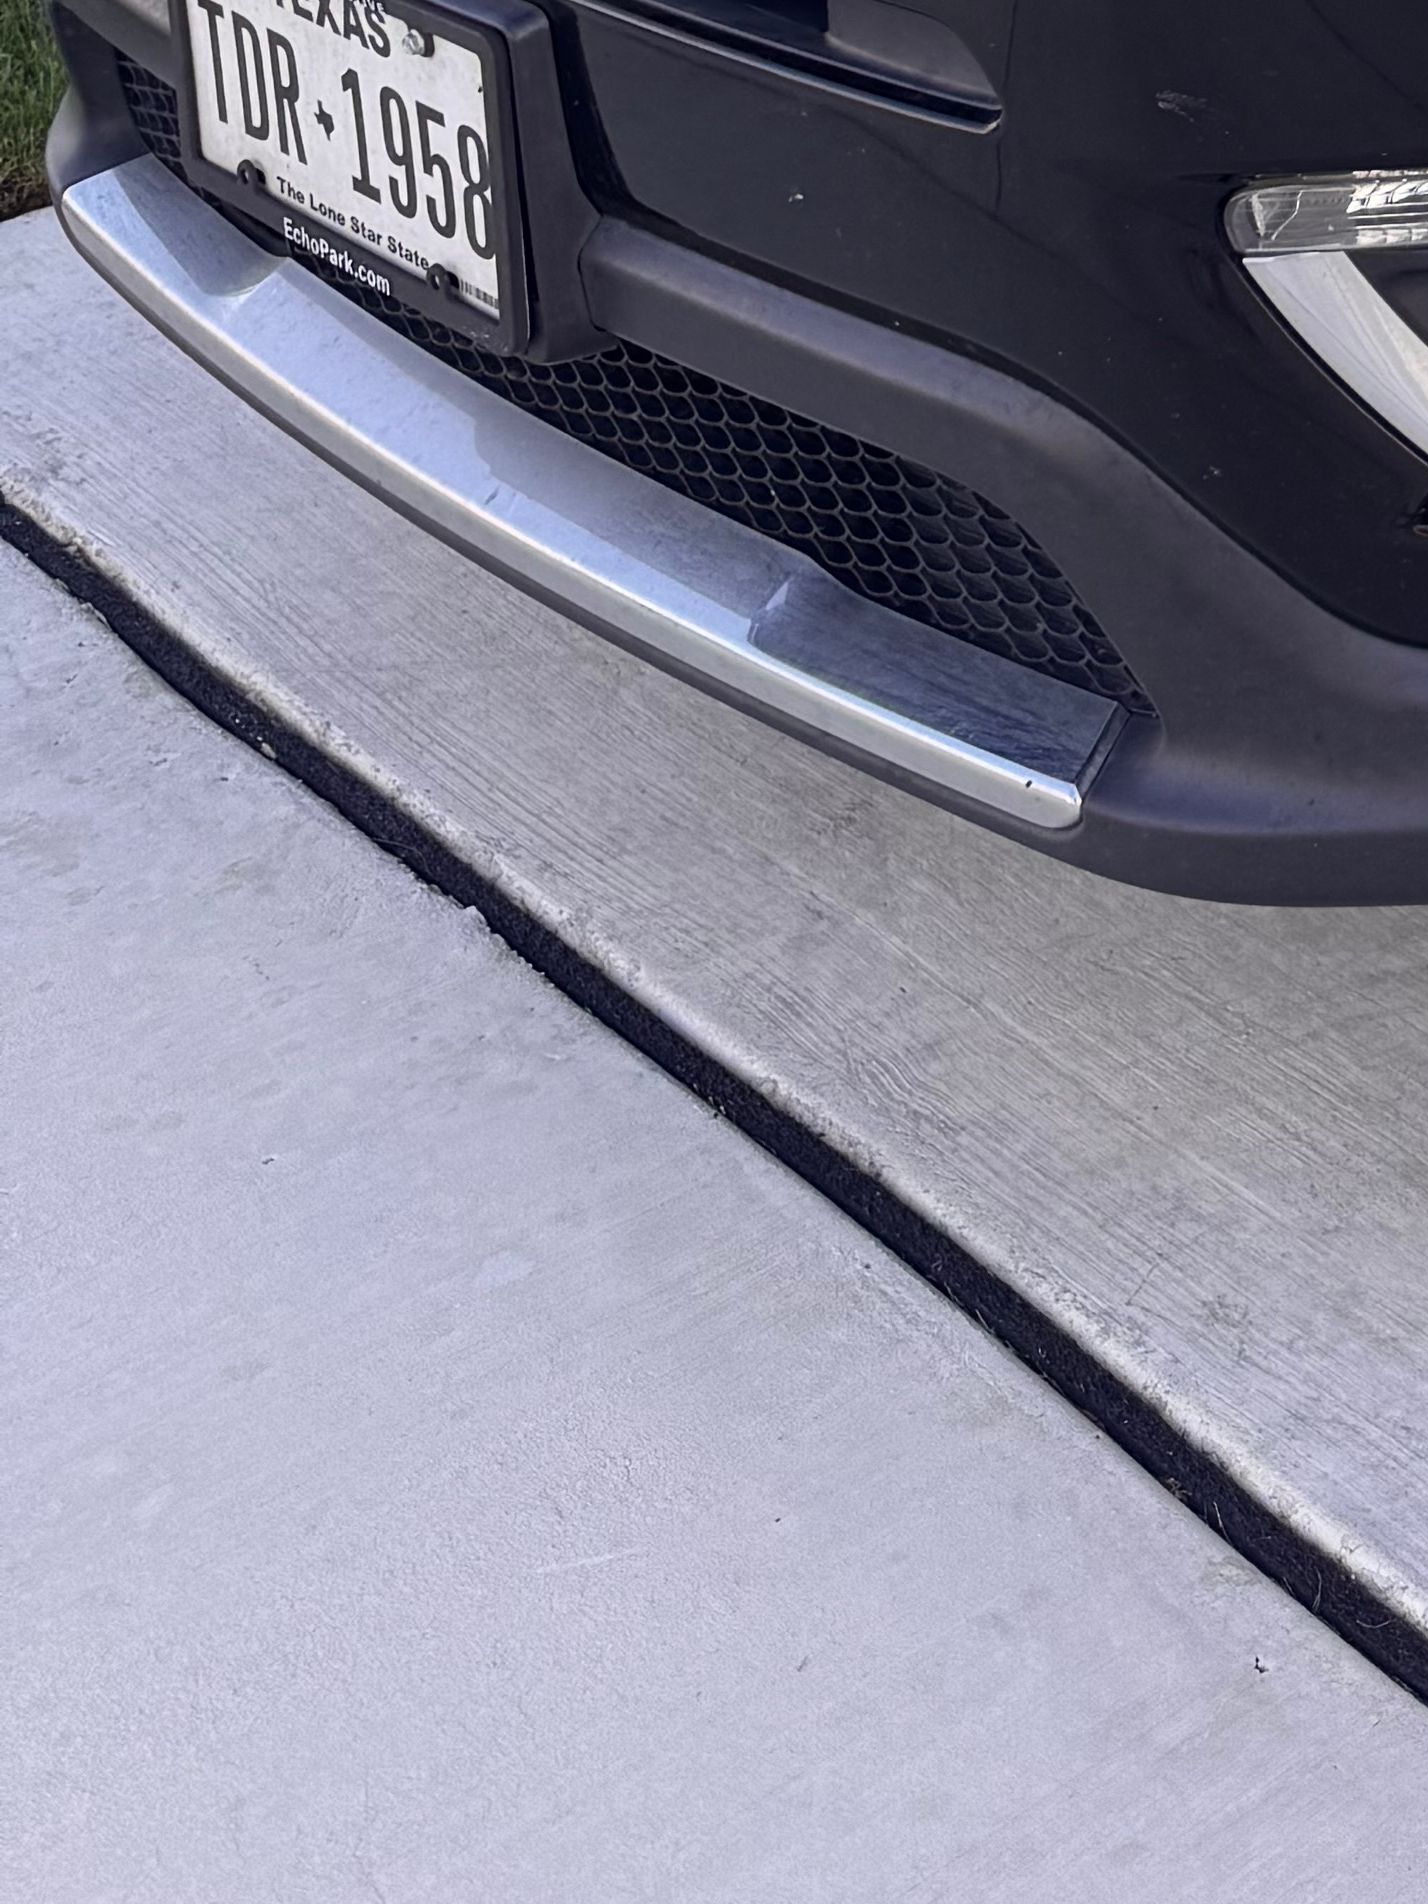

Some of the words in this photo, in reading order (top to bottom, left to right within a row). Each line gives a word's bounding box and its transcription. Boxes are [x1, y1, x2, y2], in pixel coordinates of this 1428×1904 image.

[340, 67, 497, 261] 1958
[277, 175, 305, 204] The
[309, 192, 346, 226] Lone
[350, 215, 383, 246] Star
[387, 235, 430, 271] State
[283, 217, 391, 296] EchoPark.com
